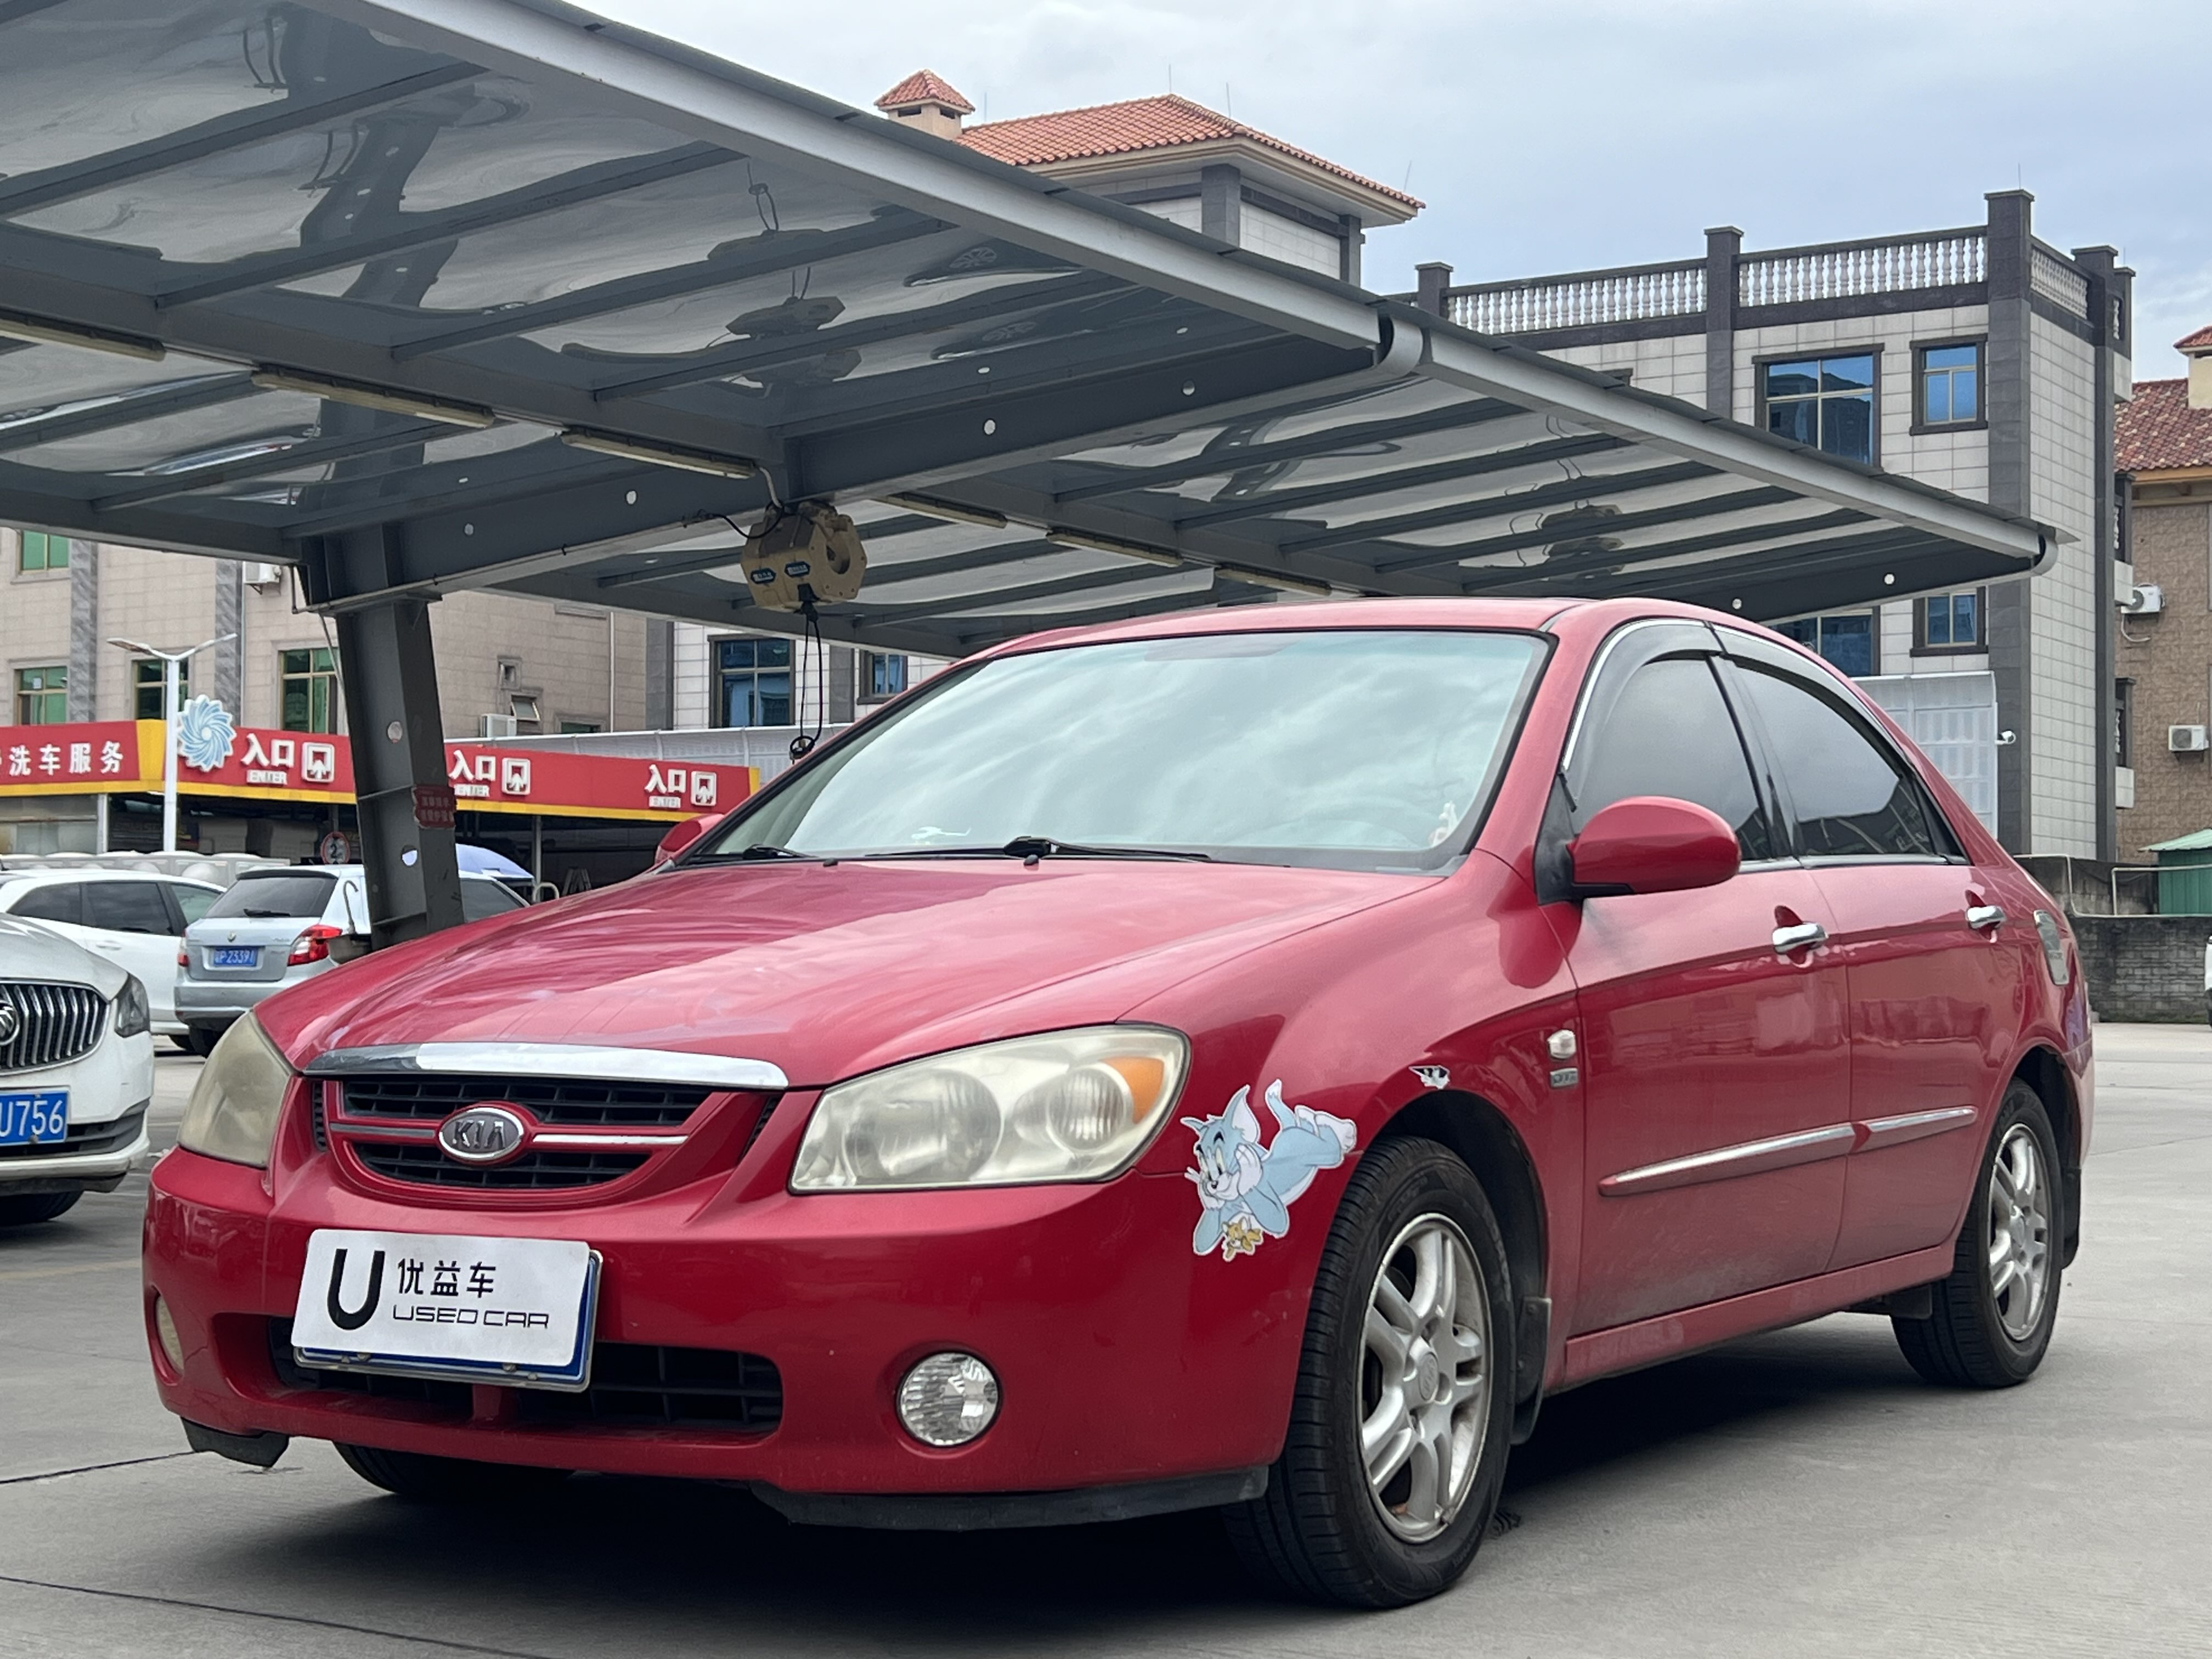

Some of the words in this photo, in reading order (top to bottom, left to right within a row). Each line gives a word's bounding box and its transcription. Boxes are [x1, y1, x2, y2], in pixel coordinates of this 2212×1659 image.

[0, 741, 123, 776] 洗车服务
[241, 733, 295, 768] 入口
[448, 749, 496, 782] 入口
[644, 764, 686, 794] 入口
[0, 1099, 64, 1137] U756
[452, 1119, 506, 1149] KIA
[327, 1248, 386, 1330] U
[397, 1258, 496, 1299] 优益车
[393, 1304, 478, 1324] USED
[483, 1310, 550, 1329] CAR
